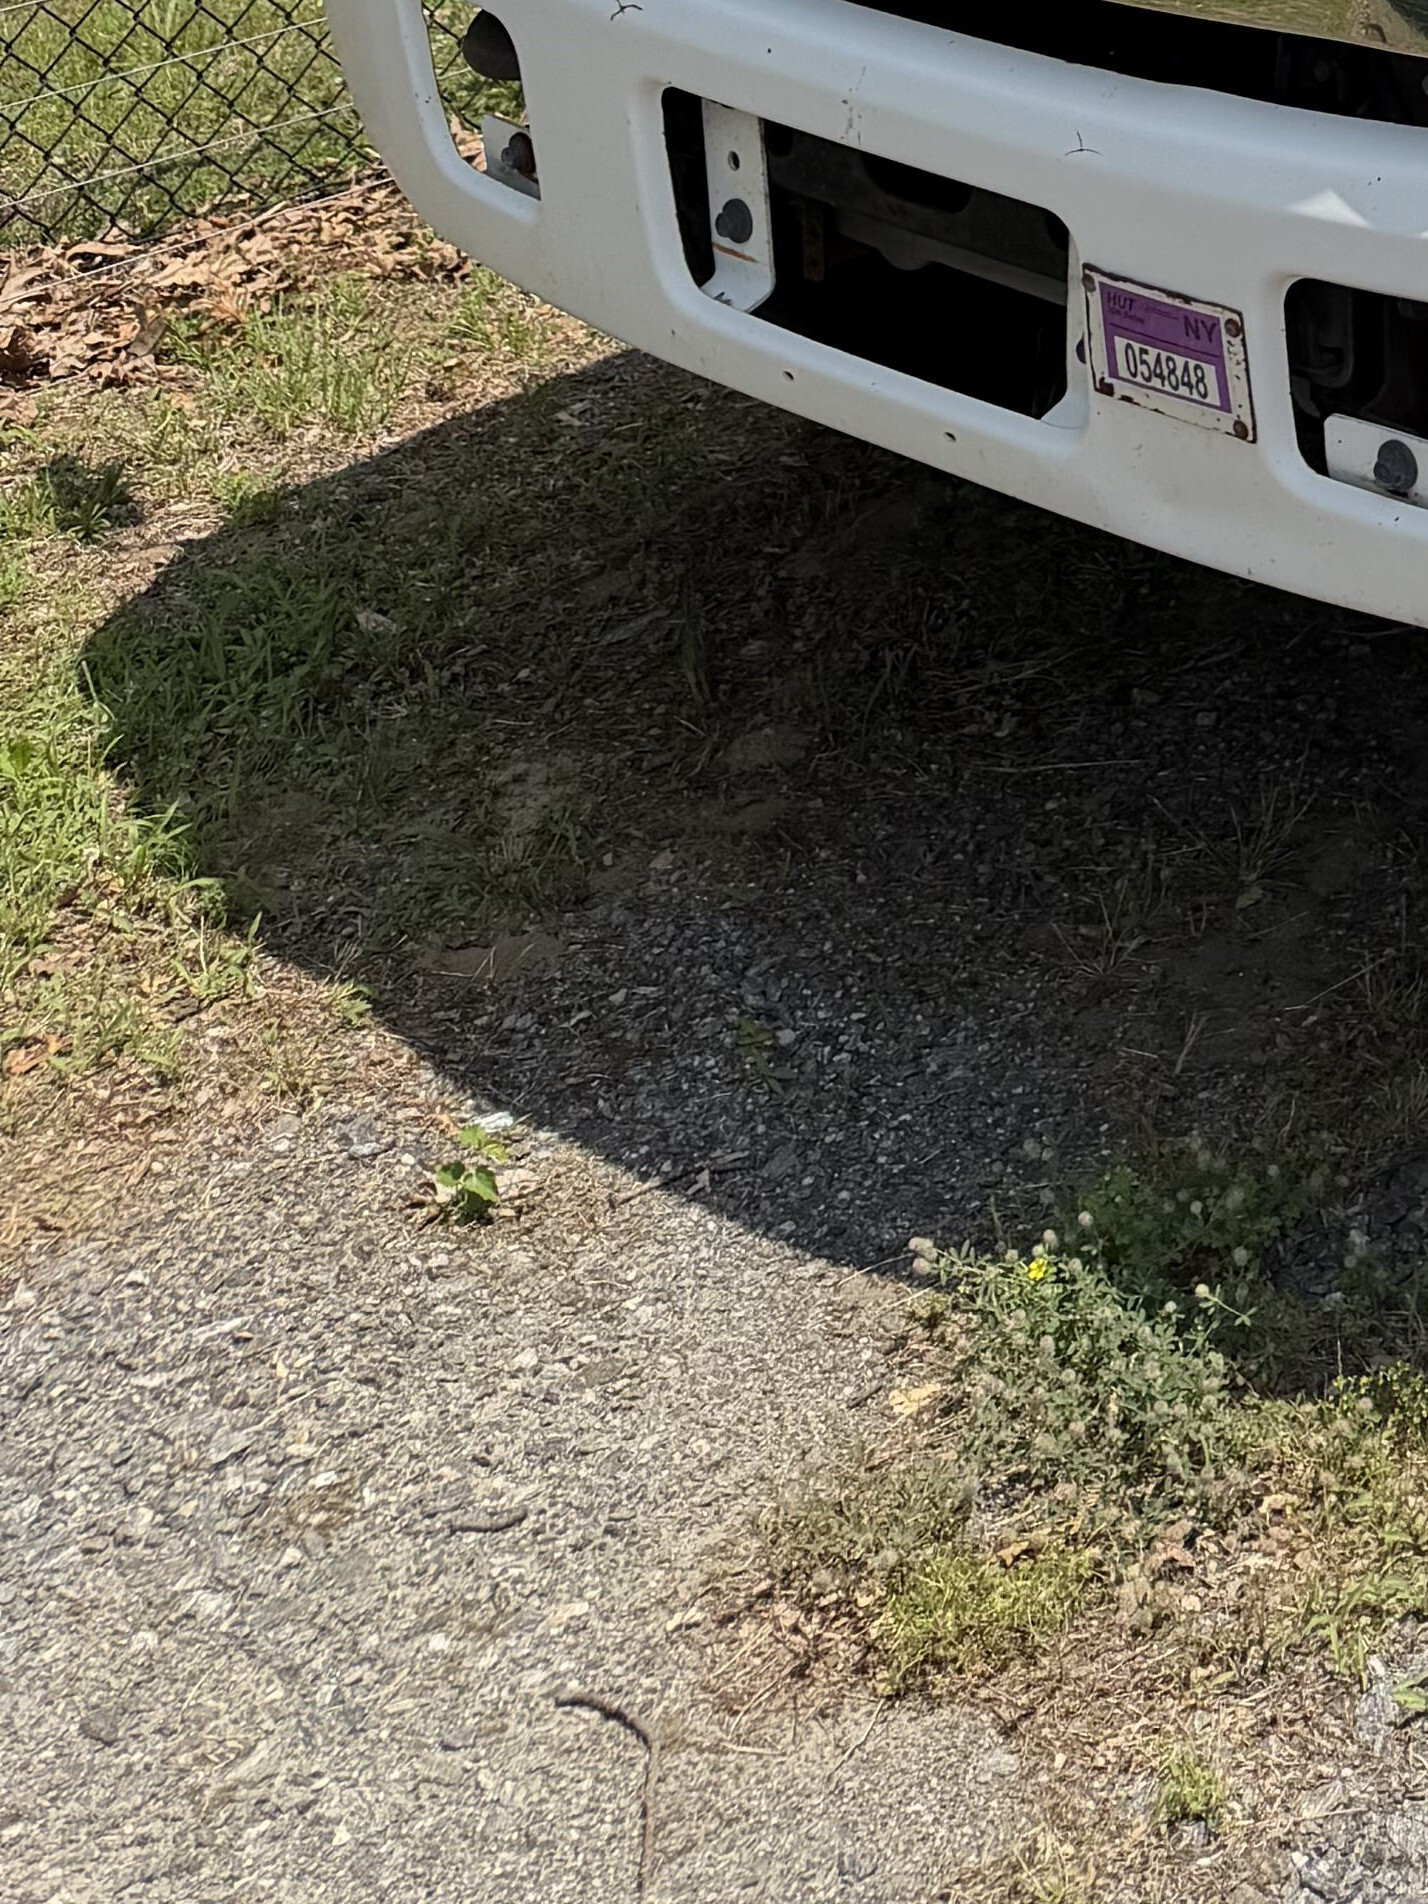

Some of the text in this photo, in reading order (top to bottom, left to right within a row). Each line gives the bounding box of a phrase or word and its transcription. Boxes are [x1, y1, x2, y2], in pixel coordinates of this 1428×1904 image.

[1106, 291, 1136, 312] HUT
[1184, 316, 1218, 343] NY
[1124, 342, 1209, 400] 054848
